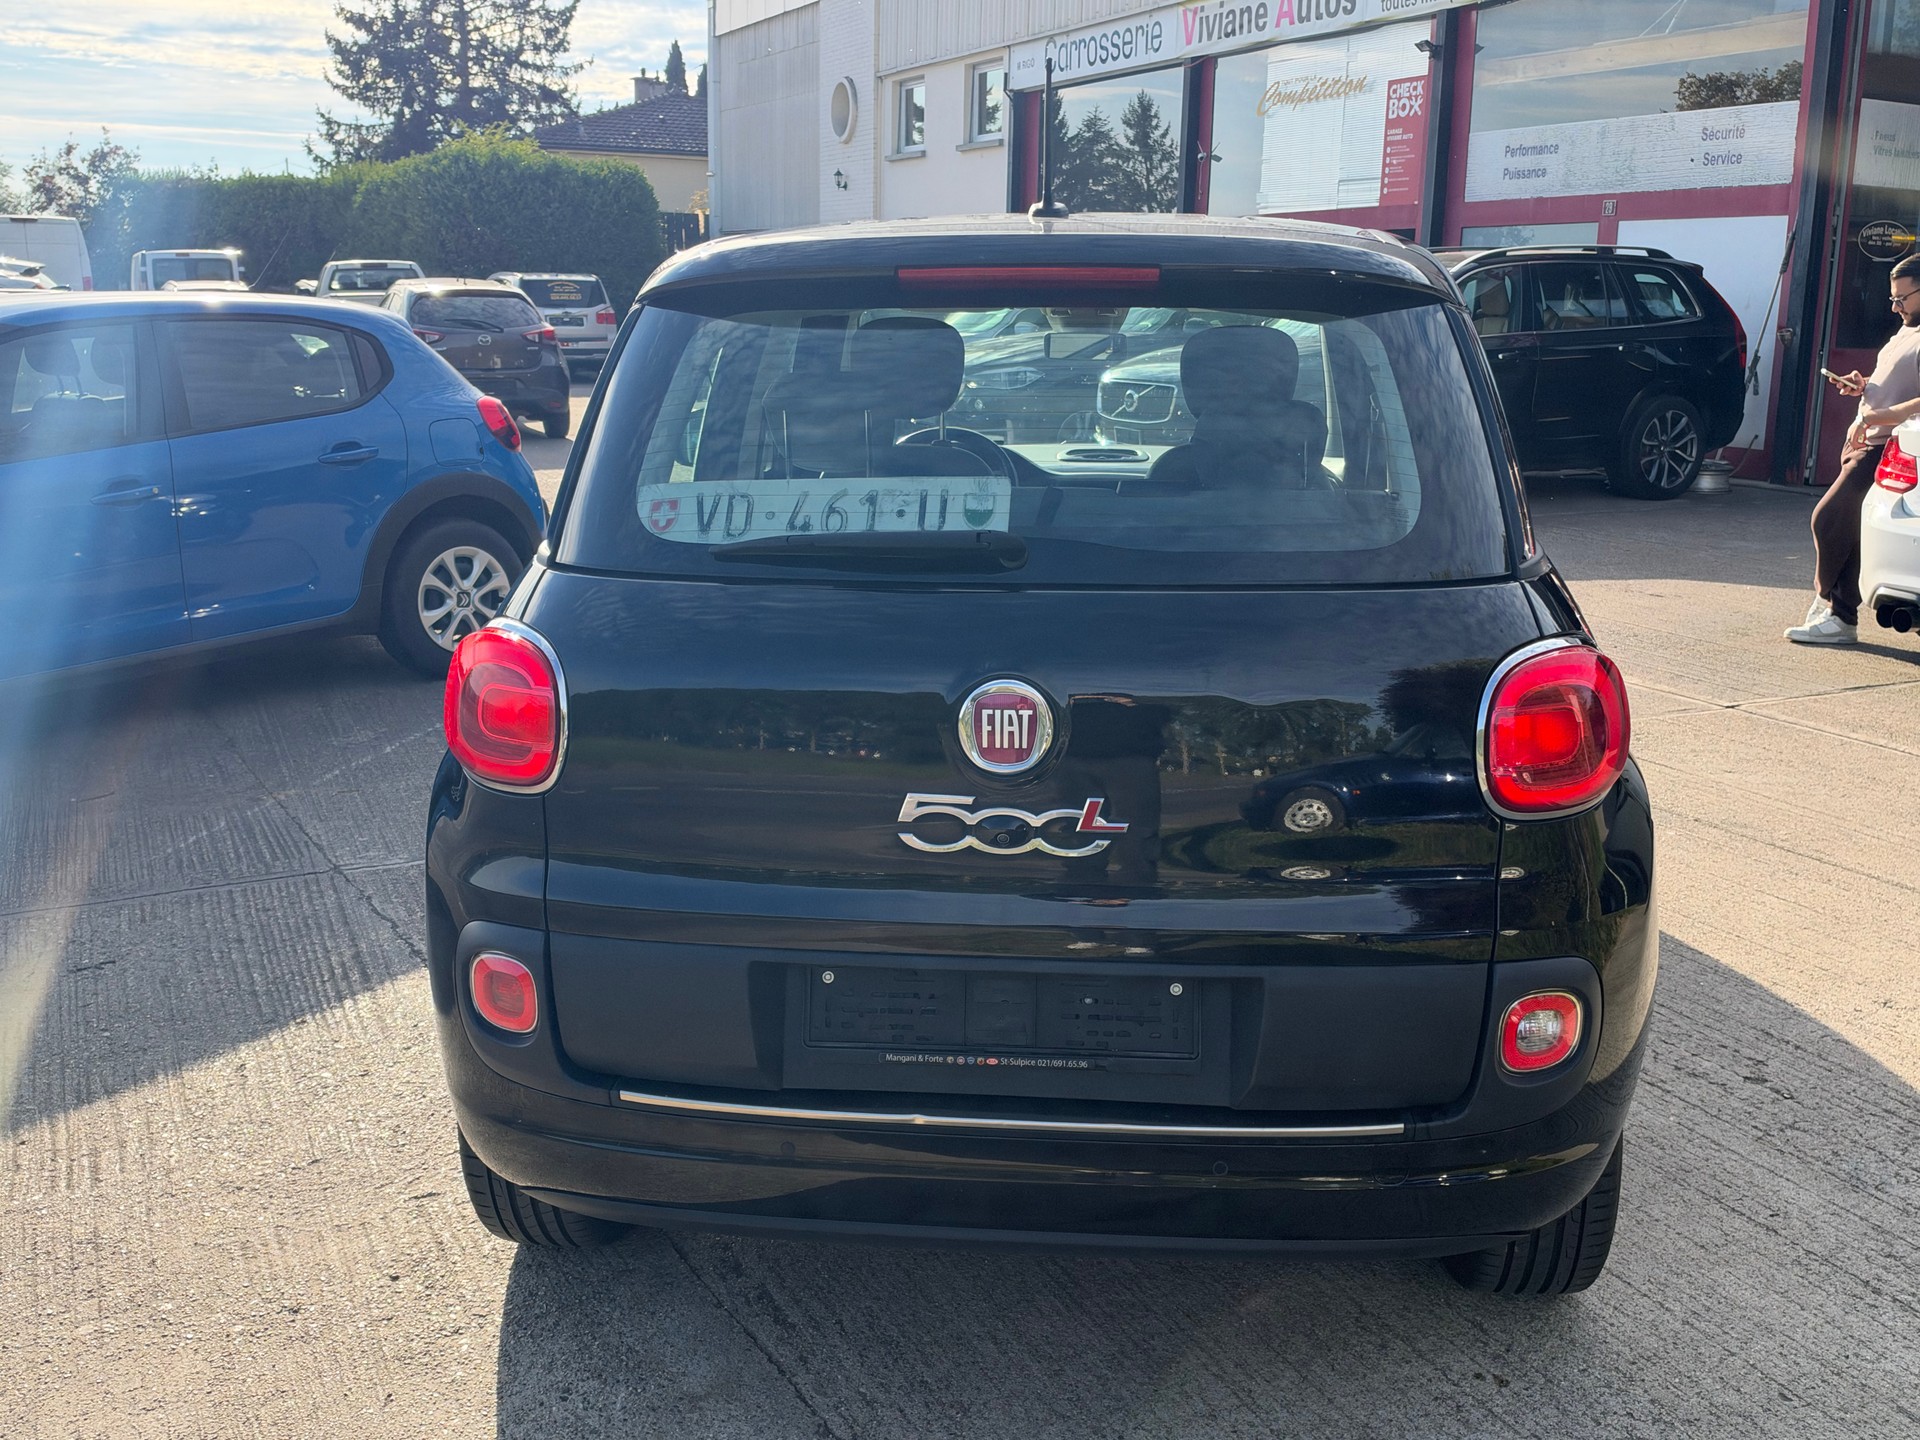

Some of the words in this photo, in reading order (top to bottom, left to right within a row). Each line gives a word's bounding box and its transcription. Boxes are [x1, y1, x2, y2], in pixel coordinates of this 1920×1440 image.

[1182, 2, 1268, 46] Viviane
[1274, 0, 1357, 29] Autos
[1045, 20, 1162, 74] Carrosserie
[1389, 80, 1424, 99] CHECK
[1388, 95, 1423, 119] BOX
[1701, 124, 1745, 141] Sécurité
[1505, 144, 1559, 158] Performance
[1703, 150, 1742, 166] Service
[1503, 167, 1547, 180] Puissance
[981, 709, 1033, 749] FIAT
[886, 1054, 916, 1063] Mangani
[1001, 1057, 1035, 1067] St-Sulpice
[1037, 1060, 1088, 1068] 021/691.65.96
